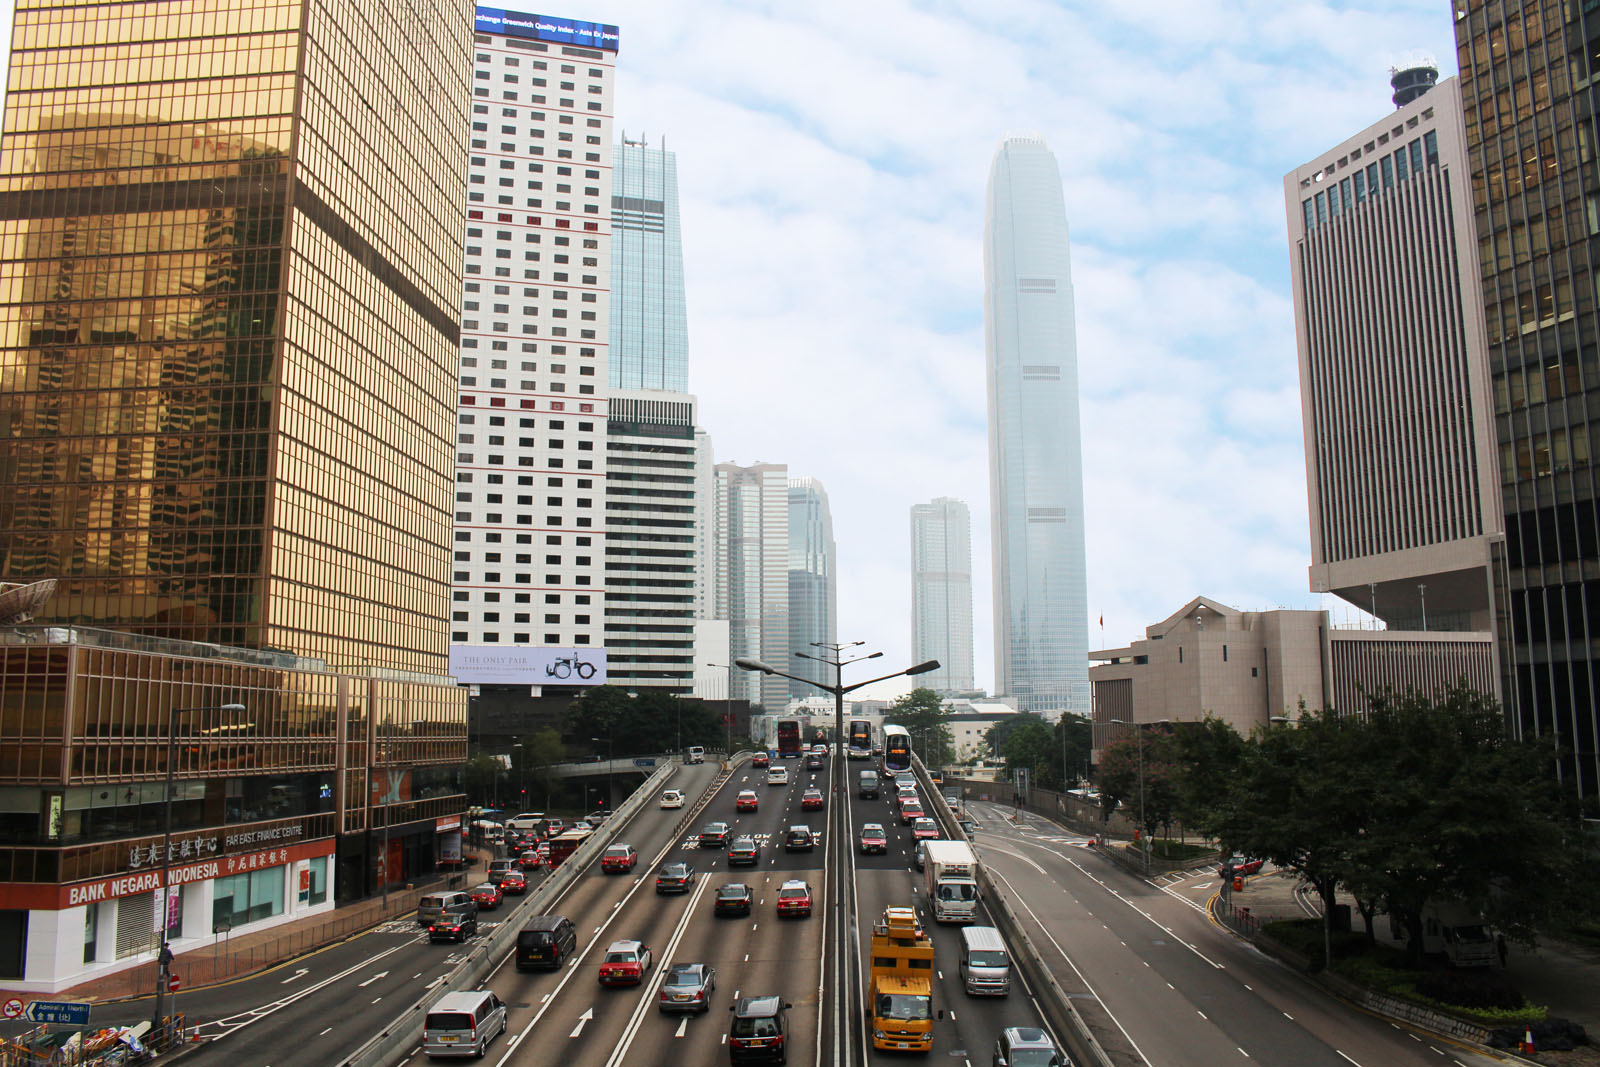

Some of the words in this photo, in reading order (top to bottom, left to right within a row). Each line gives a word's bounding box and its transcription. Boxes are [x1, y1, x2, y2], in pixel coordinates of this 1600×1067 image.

[476, 14, 501, 25] xchange
[502, 17, 534, 28] Greenwich
[535, 22, 557, 33] Quality
[557, 25, 574, 34] Index
[602, 31, 619, 40] Japan
[464, 656, 480, 664] THE
[483, 656, 505, 664] ONLY
[508, 656, 528, 664] PAIR
[226, 834, 239, 847] FAR
[240, 831, 257, 845] EAST
[257, 828, 281, 841] FINANCE
[282, 826, 303, 837] CENTRE
[69, 882, 107, 905] BANK
[111, 872, 160, 897] NEGARA
[168, 862, 219, 886] NDONESIA
